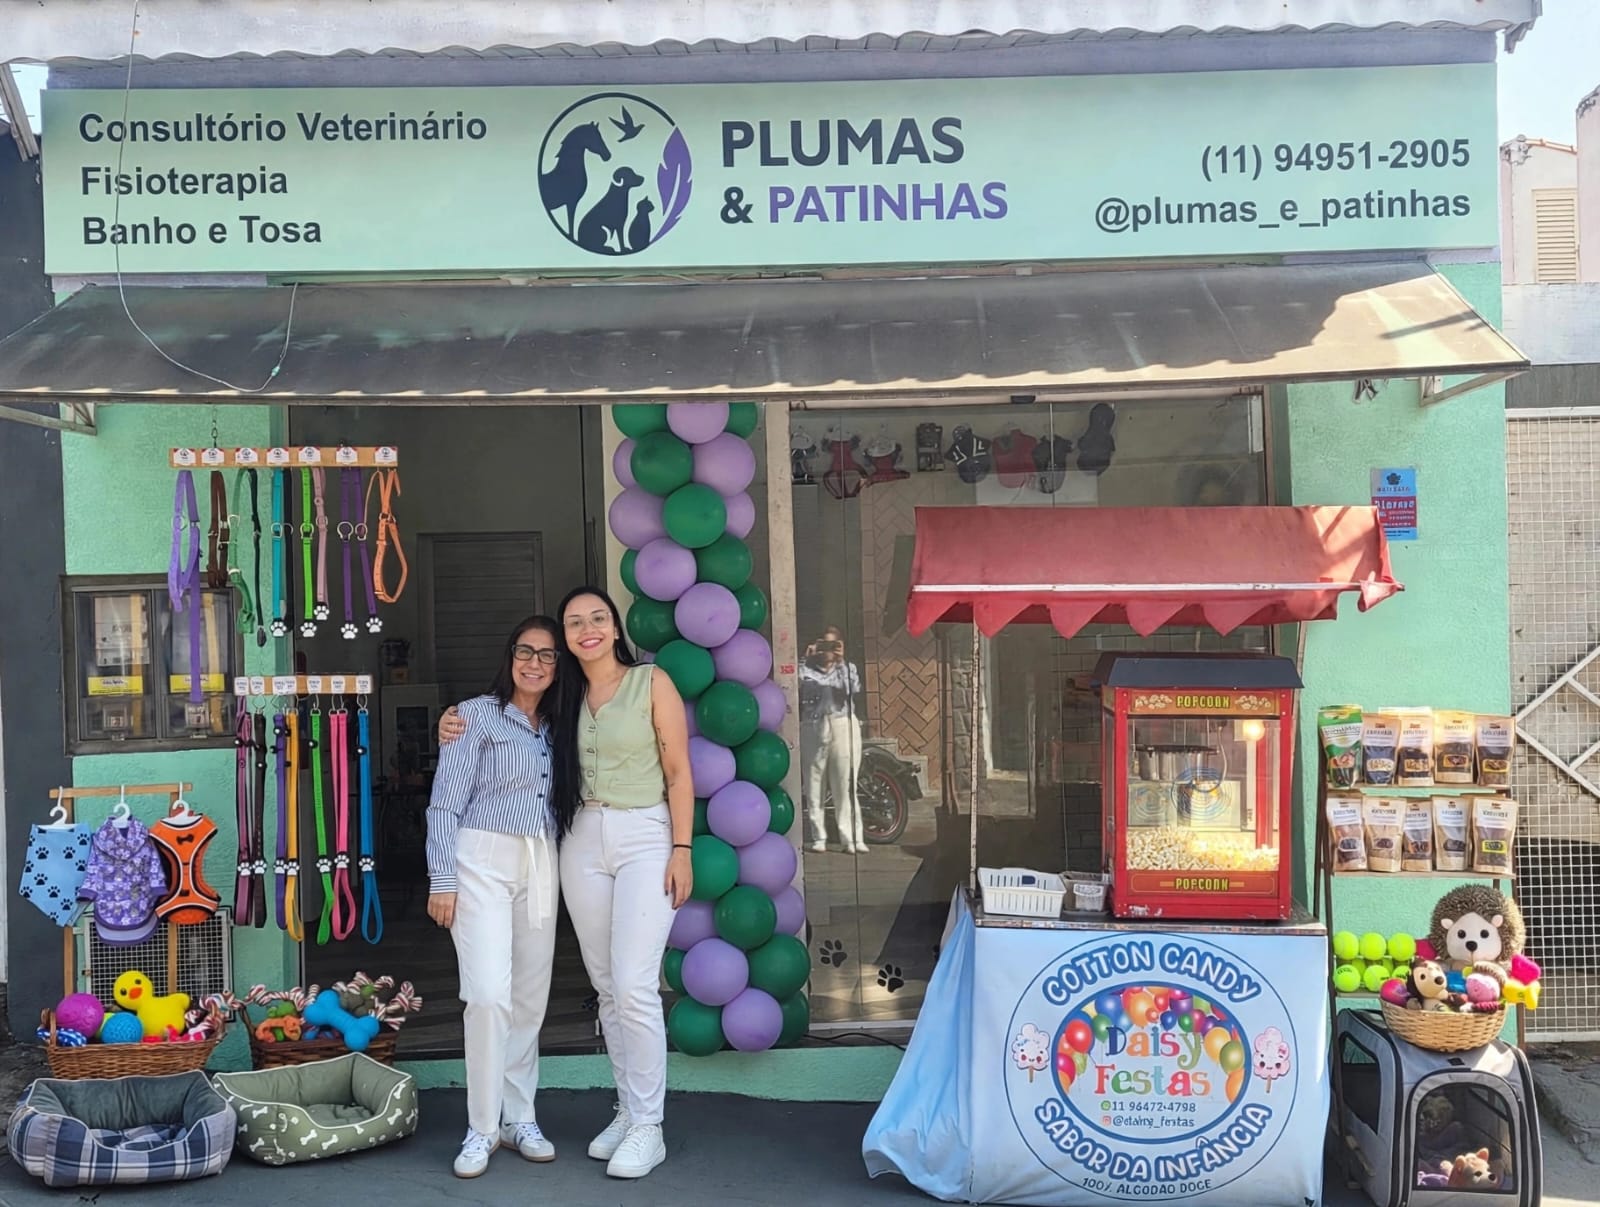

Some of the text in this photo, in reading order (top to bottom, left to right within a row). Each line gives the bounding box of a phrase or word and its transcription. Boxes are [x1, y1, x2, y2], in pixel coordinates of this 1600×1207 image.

[78, 111, 487, 142] Consultório Veterinário
[721, 117, 964, 168] PLUMAS
[1201, 138, 1470, 181] (11) 94951-2905
[81, 166, 288, 200] Fisioterapia
[720, 181, 1009, 224] & PATINHAS
[82, 215, 322, 245] Banho e Tosa
[1095, 189, 1471, 233] @plumas_e_patinhas
[1043, 941, 1262, 1006] COTTON CANDY
[1105, 1026, 1203, 1069] Daisy
[1095, 1064, 1210, 1096] Festas
[1112, 1101, 1124, 1111] 11
[1034, 1097, 1273, 1182] SABOR DA INFÂNCIA
